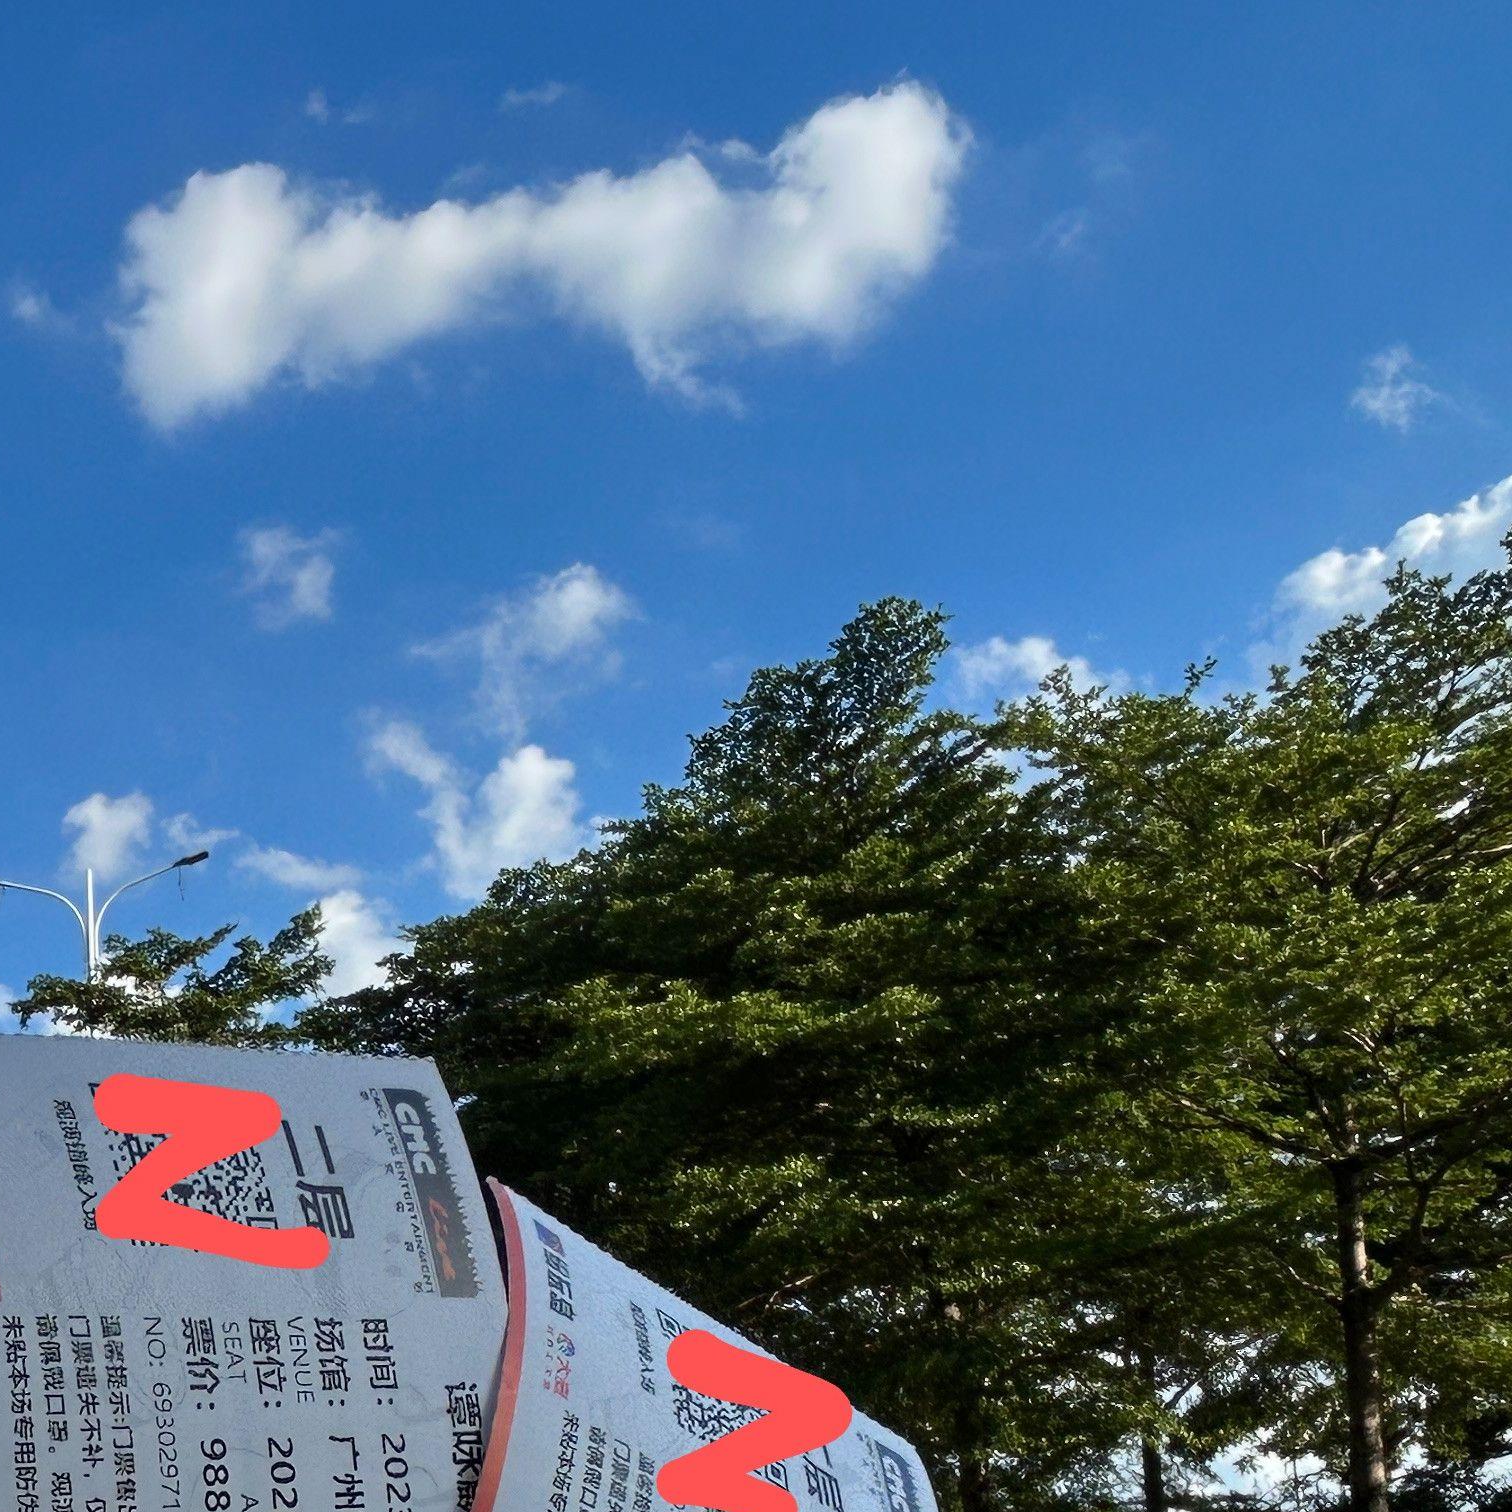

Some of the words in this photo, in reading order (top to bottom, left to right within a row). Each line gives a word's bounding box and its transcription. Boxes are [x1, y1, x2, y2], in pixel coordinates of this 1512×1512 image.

[280, 1120, 354, 1239] 二层
[392, 1102, 437, 1175] CMC
[142, 1316, 165, 1367] NO:
[180, 1317, 219, 1410] 票价：
[221, 1321, 246, 1383] SEAT
[247, 1318, 286, 1408] 座位：
[285, 1316, 314, 1403] VENUE
[313, 1317, 351, 1407] 场馆：
[361, 1318, 397, 1407] 时间：
